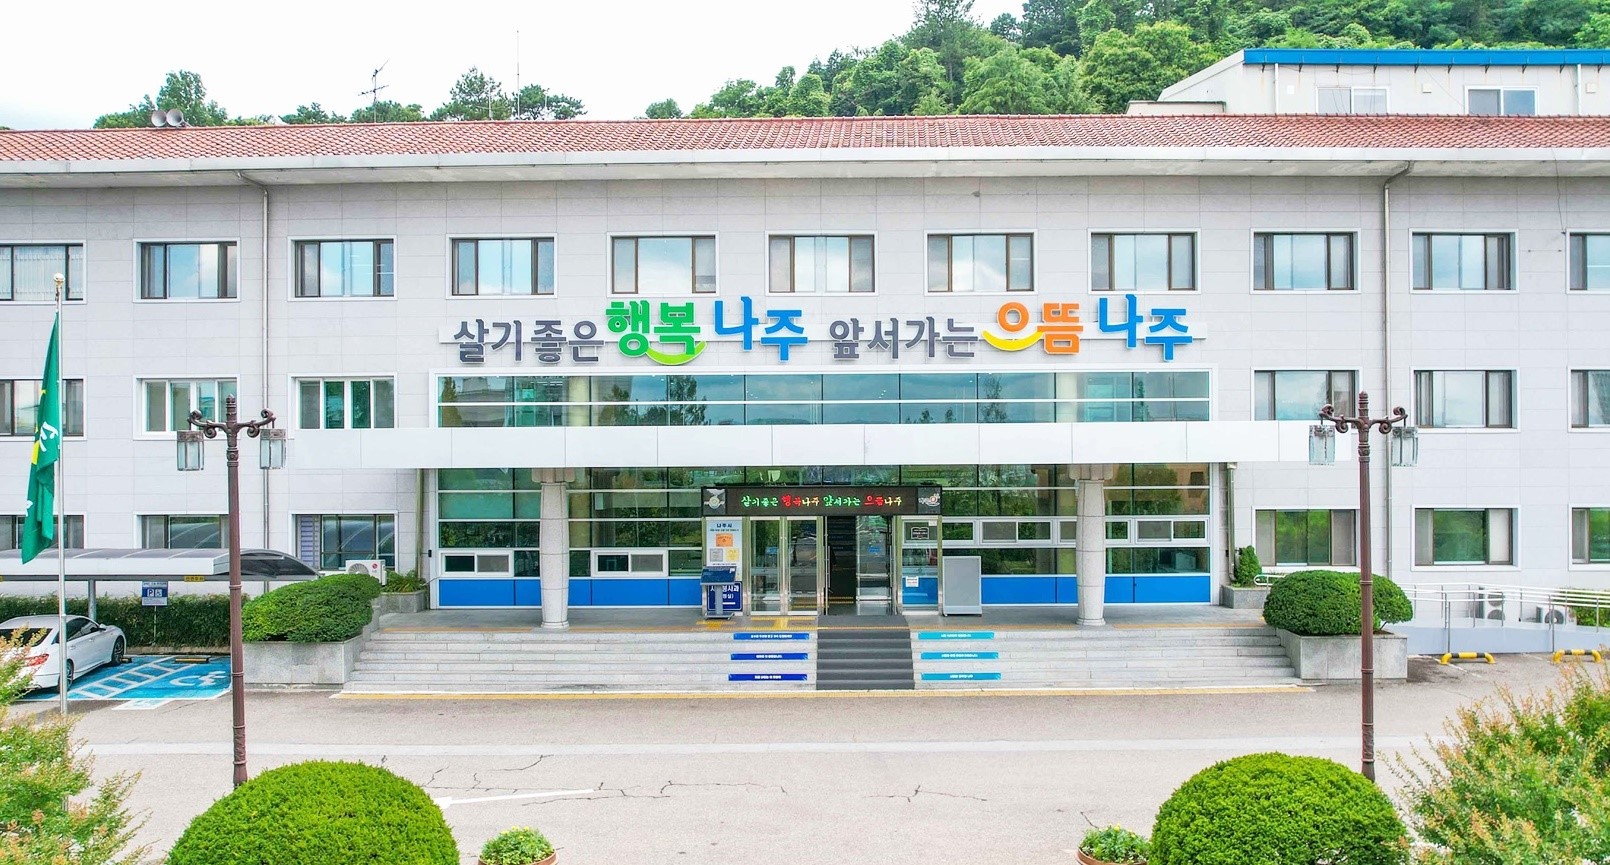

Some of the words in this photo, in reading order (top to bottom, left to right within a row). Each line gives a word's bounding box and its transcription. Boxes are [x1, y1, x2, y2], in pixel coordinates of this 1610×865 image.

[605, 300, 702, 358] 행복
[713, 296, 809, 362] 나주
[829, 316, 980, 360] 앞서가는
[996, 301, 1084, 355] 으뜸
[1098, 293, 1193, 362] 나주
